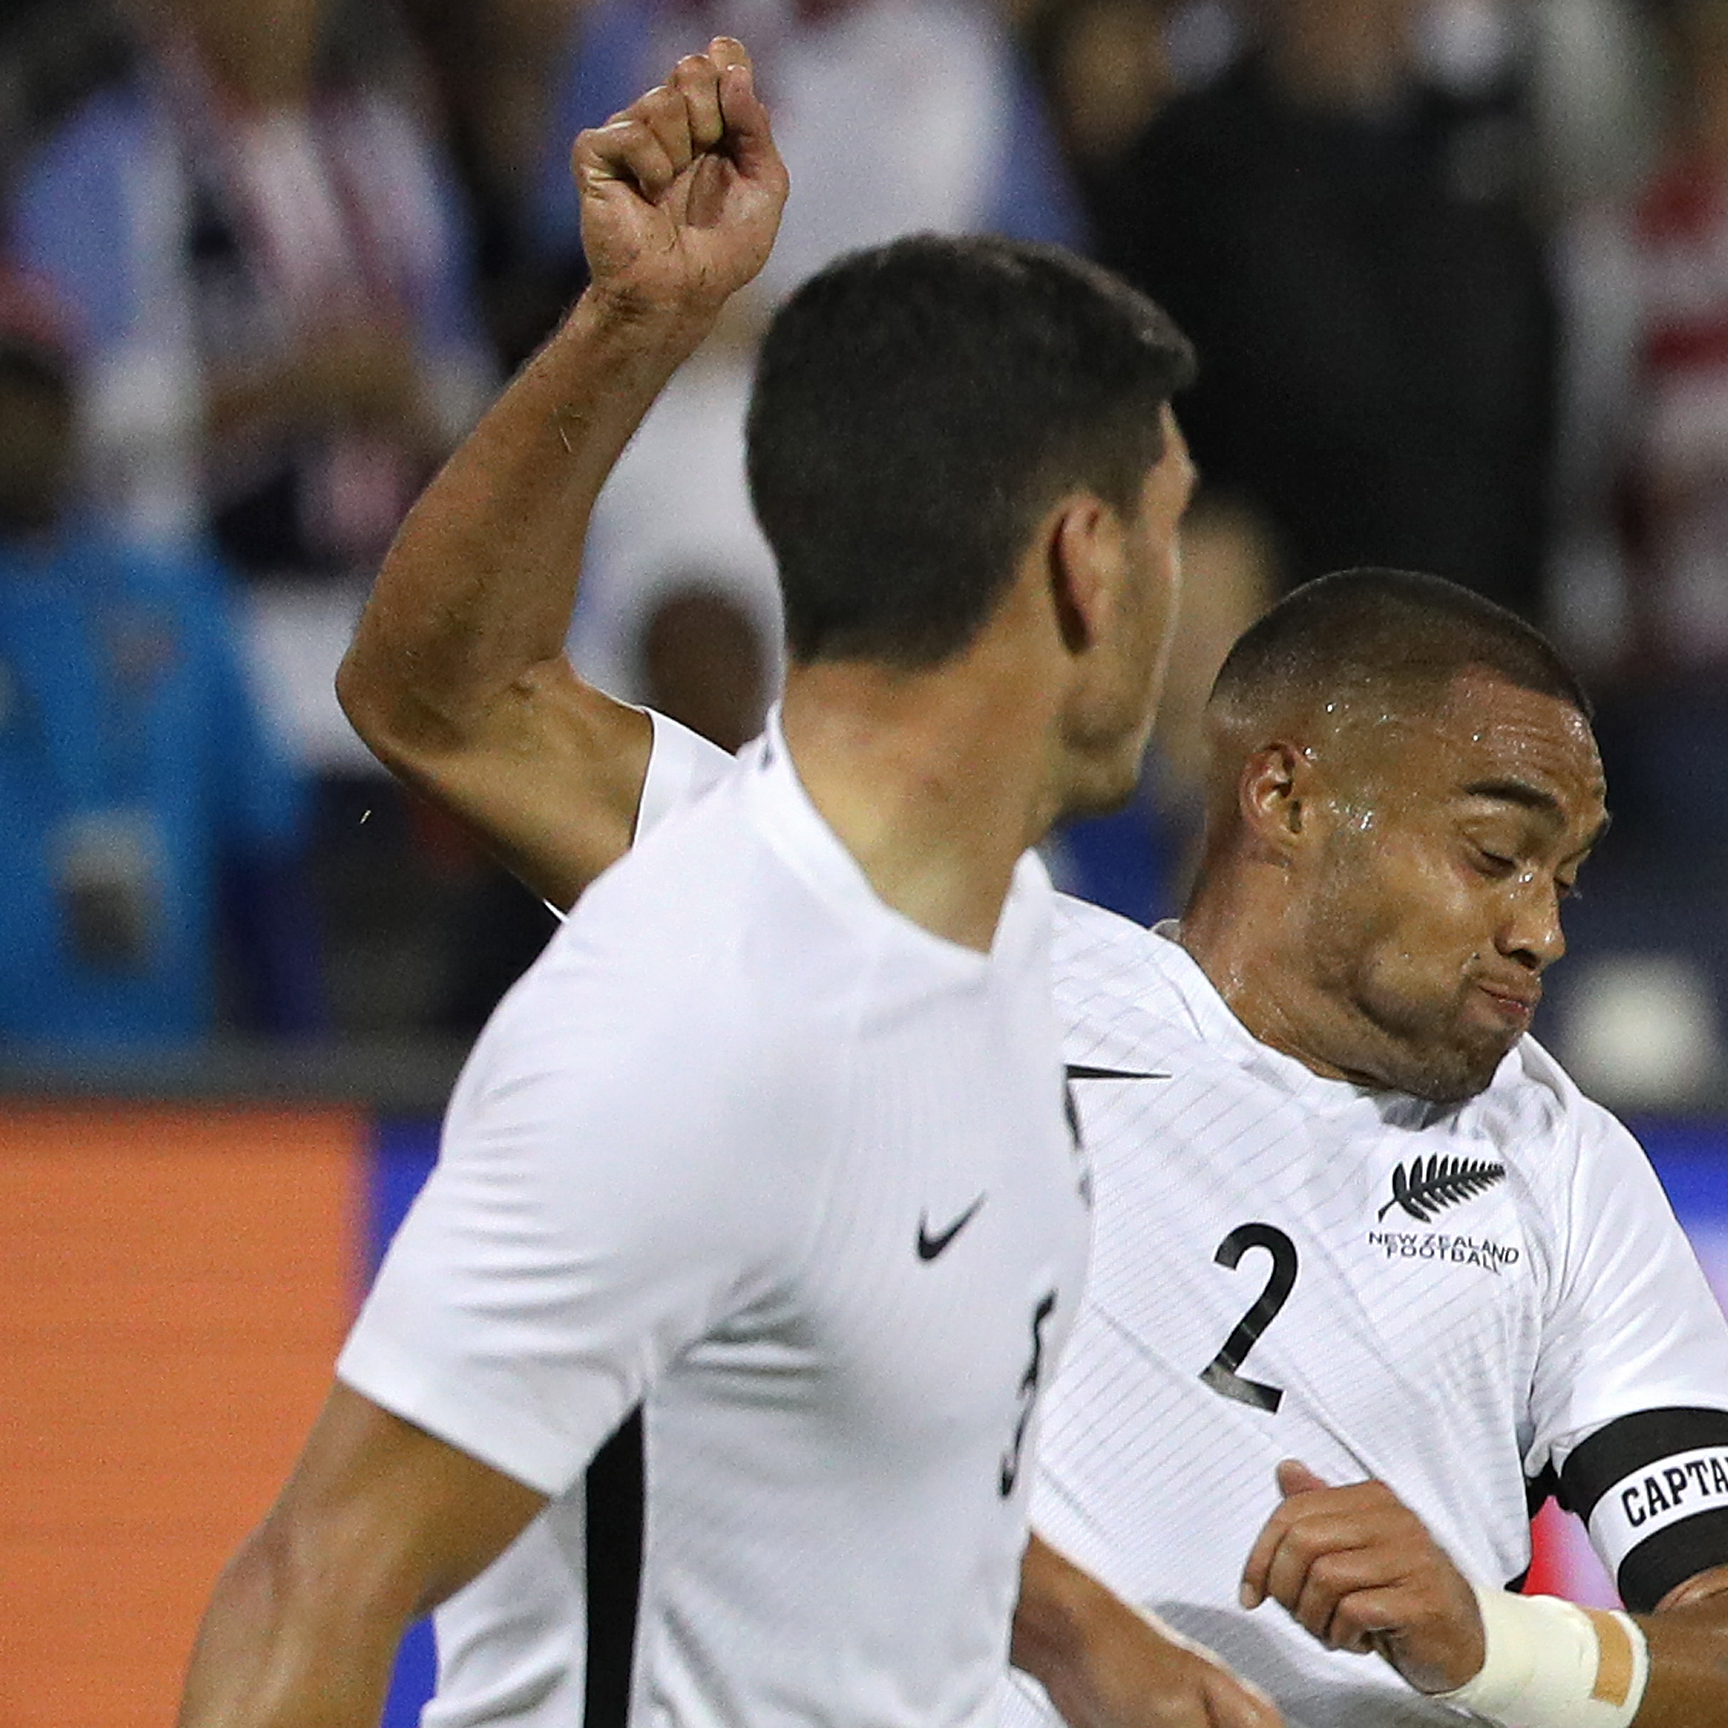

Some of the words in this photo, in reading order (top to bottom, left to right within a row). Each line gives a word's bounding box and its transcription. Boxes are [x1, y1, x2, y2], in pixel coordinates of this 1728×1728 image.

[1367, 1230, 1418, 1246] NEW
[1422, 1232, 1520, 1265] ZEALAND
[1199, 1222, 1300, 1414] 2
